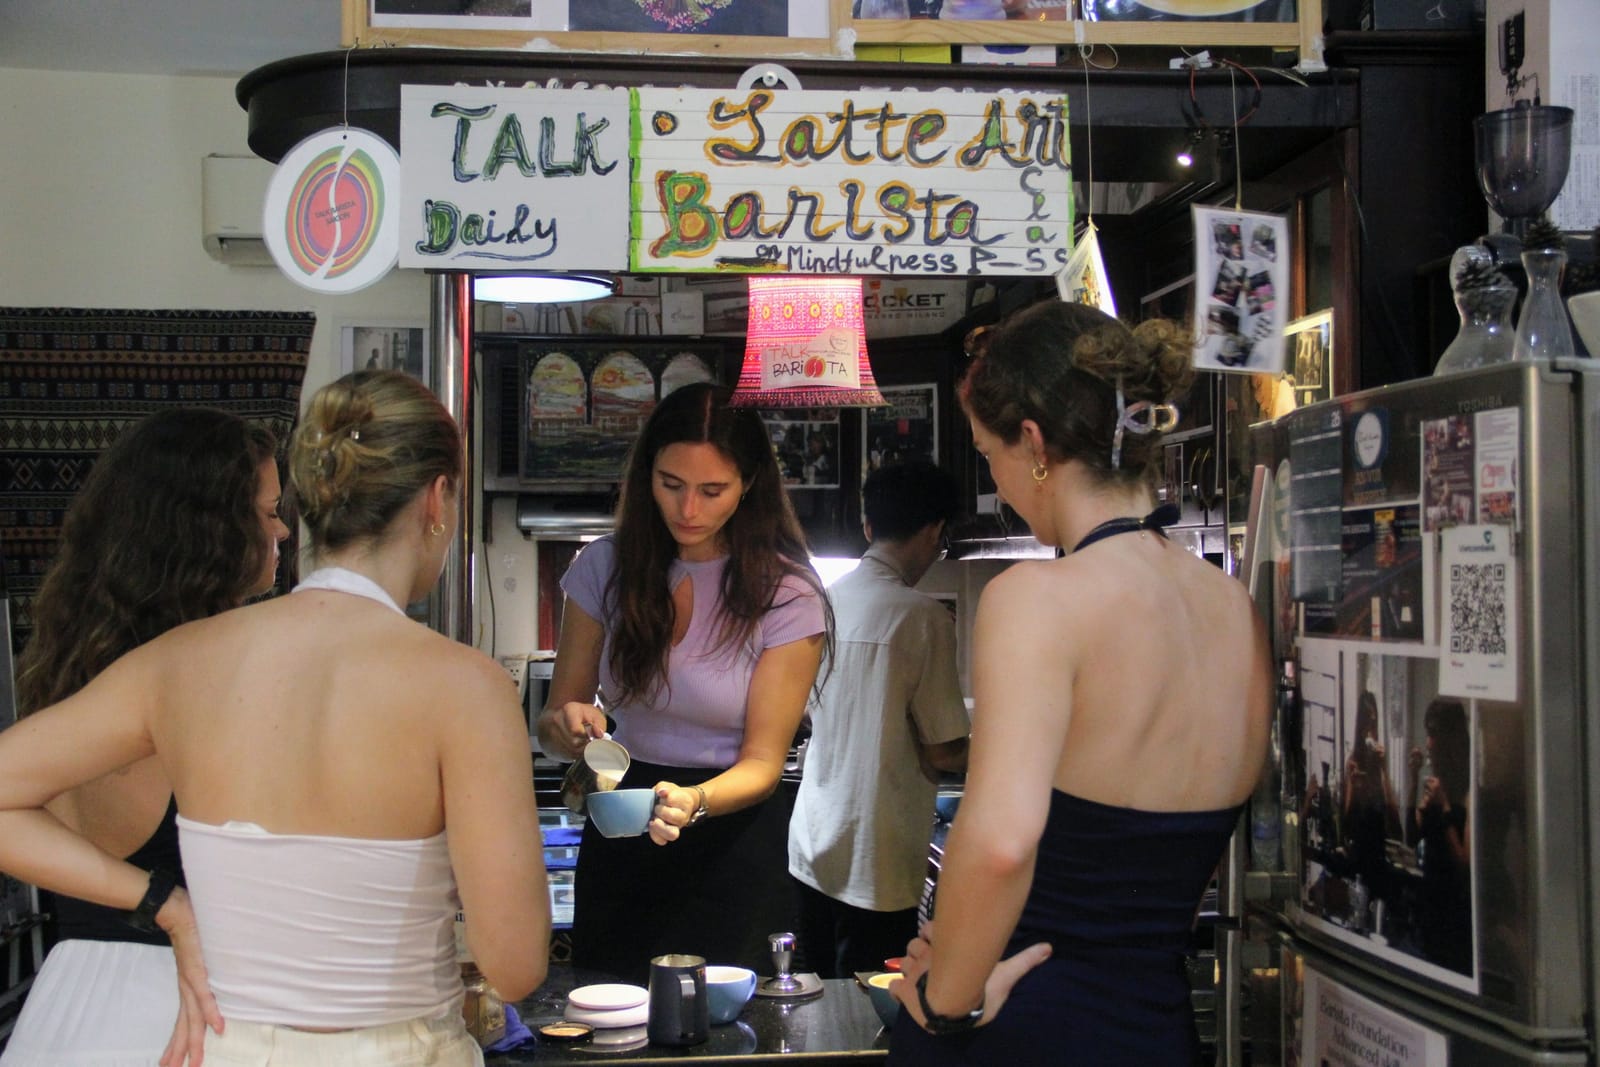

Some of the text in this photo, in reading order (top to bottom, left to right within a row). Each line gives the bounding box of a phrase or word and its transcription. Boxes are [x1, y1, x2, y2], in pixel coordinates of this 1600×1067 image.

[431, 102, 618, 183] TALK
[704, 90, 952, 169] Latte
[415, 199, 558, 257] Daily
[649, 170, 1006, 259] Barista
[756, 244, 783, 260] on
[788, 245, 958, 274] Mindfulness
[864, 293, 946, 308] OCKET
[768, 344, 809, 361] TALK
